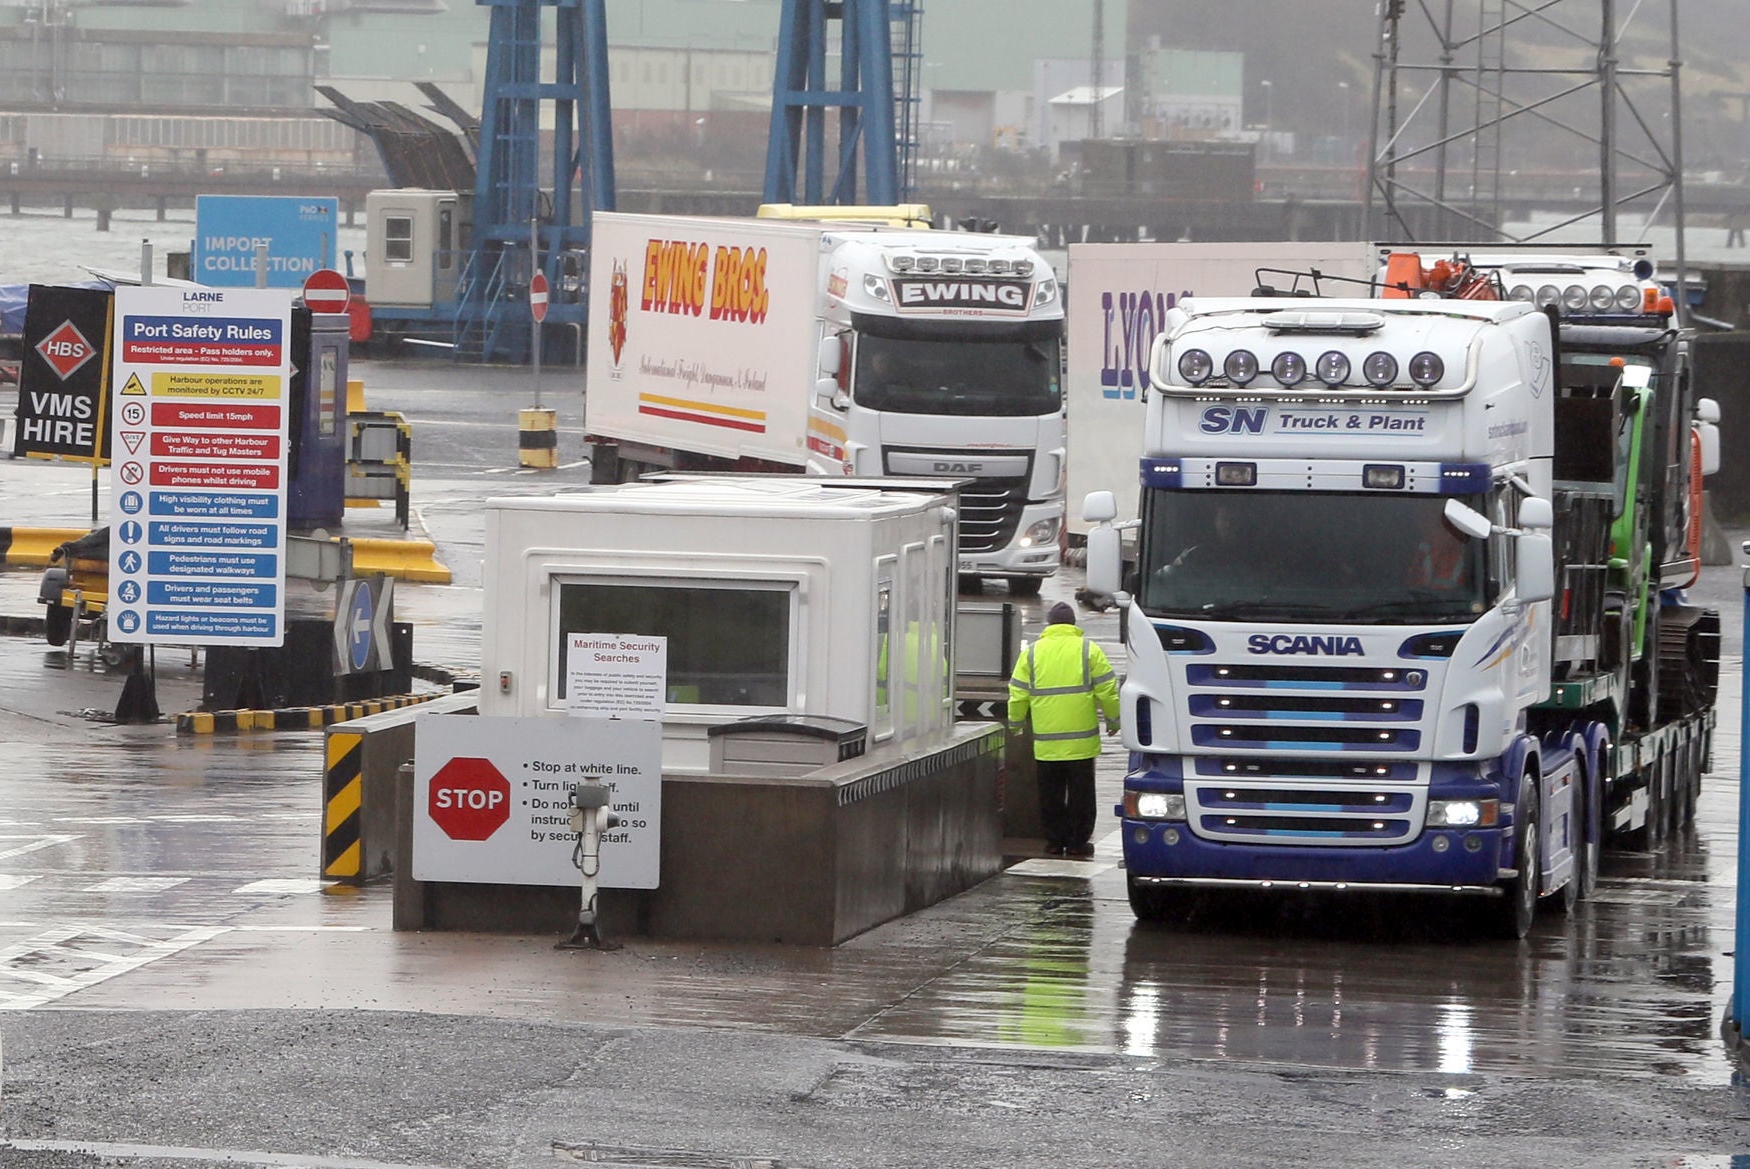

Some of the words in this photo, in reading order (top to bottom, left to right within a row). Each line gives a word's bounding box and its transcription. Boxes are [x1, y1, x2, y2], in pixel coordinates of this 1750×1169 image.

[205, 237, 273, 251] IMPORT
[205, 256, 314, 271] COLLECTION
[641, 238, 710, 317] EWING
[709, 246, 770, 325] BROS.
[183, 292, 224, 302] LARNE
[901, 283, 1024, 306] EWING
[182, 303, 213, 313] PORT
[134, 323, 168, 337] Port
[172, 324, 222, 341] Safety
[227, 327, 272, 340] Rules
[46, 340, 85, 358] HBS
[130, 345, 173, 354] Restricted
[200, 347, 220, 355] Pass
[222, 348, 253, 356] holders
[254, 349, 274, 358] only.
[170, 376, 203, 384] Harbour
[205, 377, 248, 386] operations
[211, 387, 220, 395] by
[222, 387, 246, 395] CCTV
[30, 391, 92, 419] VMS
[127, 409, 140, 419] 15
[179, 410, 204, 420] Speed
[206, 410, 224, 419] limit
[226, 411, 253, 421] 15mph
[1201, 407, 1267, 434] SN
[1279, 415, 1338, 429] Truck
[1345, 416, 1360, 429] &
[1368, 416, 1425, 431] Plant
[23, 418, 94, 446] HIRE
[163, 435, 181, 444] Give
[182, 436, 200, 445] Way
[212, 437, 233, 446] other
[235, 437, 268, 446] Harbour
[168, 445, 193, 454] Traffic
[194, 446, 210, 454] and
[213, 447, 227, 456] Tug
[229, 447, 262, 456] Masters
[158, 465, 187, 474] Drivers
[243, 468, 270, 476] mobile
[933, 463, 984, 473] DAF
[171, 476, 201, 485] phones
[203, 476, 227, 484] whilst
[229, 477, 257, 487] driving
[159, 495, 178, 505] High
[180, 495, 212, 506] visibility
[214, 496, 246, 506] clothing
[174, 505, 185, 513] be
[219, 507, 229, 515] all
[231, 507, 253, 515] times
[159, 525, 170, 533] All
[172, 525, 200, 534] drivers
[223, 526, 247, 535] follow
[248, 527, 268, 535] road
[164, 535, 184, 544] signs
[186, 535, 202, 543] and
[204, 536, 223, 544] road
[224, 536, 262, 546] markings
[169, 555, 217, 564] Pedestrians
[169, 564, 214, 575] designated
[216, 566, 256, 576] walkways
[165, 584, 193, 593] Drivers
[195, 585, 211, 593] and
[212, 587, 259, 596] passengers
[233, 596, 254, 604] belts
[155, 614, 180, 622] Hazard
[181, 615, 200, 623] lights
[209, 615, 238, 623] beacons
[190, 624, 213, 632] driving
[214, 624, 241, 633] through
[242, 625, 269, 633] harbour
[574, 640, 617, 649] Maritime
[619, 641, 660, 653] Security
[1247, 634, 1365, 656] SCANIA
[594, 653, 640, 663] Searches
[532, 761, 561, 774] Stop
[564, 763, 576, 773] at
[580, 763, 613, 775] white
[617, 764, 642, 775] line.
[532, 780, 559, 791] Turn
[436, 788, 504, 810] STOP
[532, 798, 549, 809] Do
[613, 802, 640, 812] until
[632, 819, 647, 828] so
[531, 830, 545, 843] by
[601, 832, 632, 844] staff.
